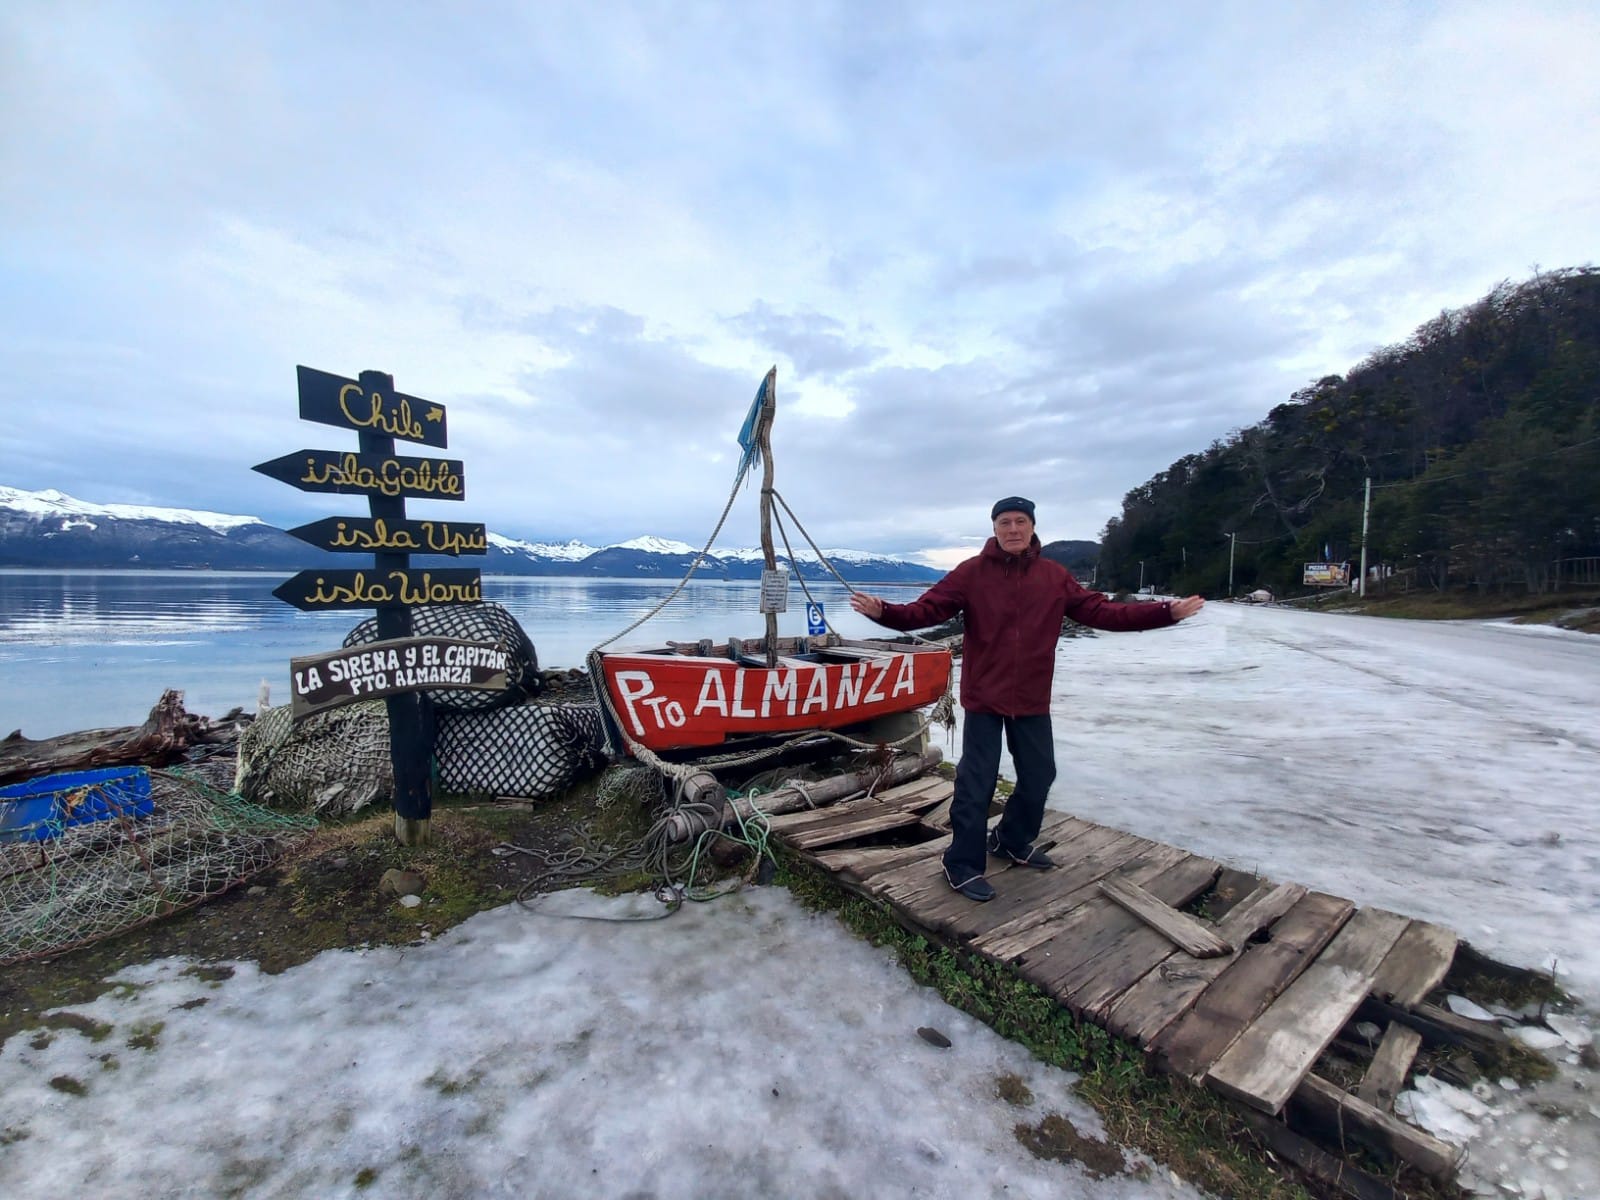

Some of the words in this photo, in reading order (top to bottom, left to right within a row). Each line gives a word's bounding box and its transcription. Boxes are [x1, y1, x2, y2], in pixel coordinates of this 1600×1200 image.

[339, 383, 424, 439] Chile
[301, 453, 380, 488] isla
[376, 459, 463, 496] Gable
[329, 518, 420, 548] isla
[304, 572, 394, 603] isla
[295, 667, 323, 694] LA
[328, 650, 399, 682] SIRENA
[422, 645, 440, 666] EL
[445, 644, 507, 670] CAPITÁN
[350, 672, 390, 695] PTO.
[395, 666, 471, 687] ALMANZA
[694, 654, 915, 718] ALMANZA
